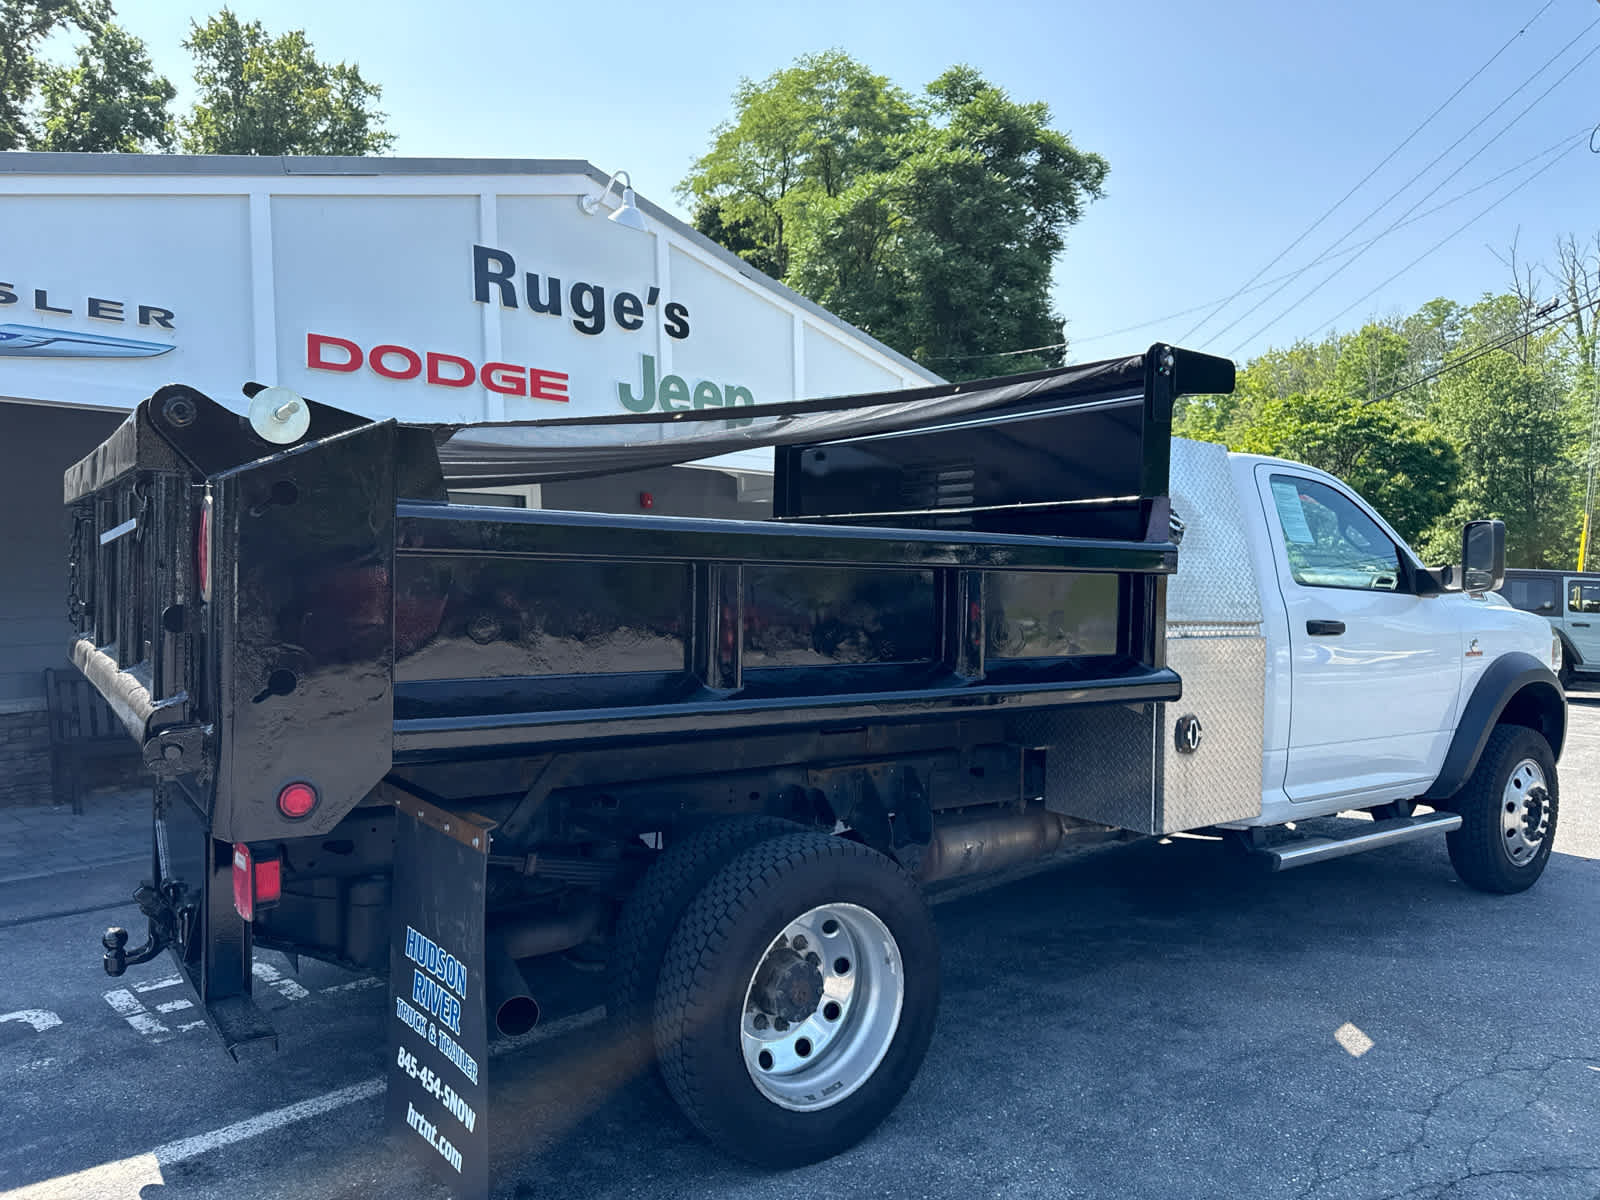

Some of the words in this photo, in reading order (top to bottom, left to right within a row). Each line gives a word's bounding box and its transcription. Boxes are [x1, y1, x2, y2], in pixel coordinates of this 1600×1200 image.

[473, 245, 690, 339] Ruge's
[307, 333, 569, 402] DODGE
[405, 925, 467, 1000] HUDSON
[412, 968, 461, 1036] RIVER
[396, 996, 428, 1039] TRUCK
[428, 1022, 437, 1047] &
[439, 1029, 478, 1086] TRAILER
[397, 1046, 476, 1134] 845-454-SNOW
[406, 1101, 463, 1174] hrtnt.com
